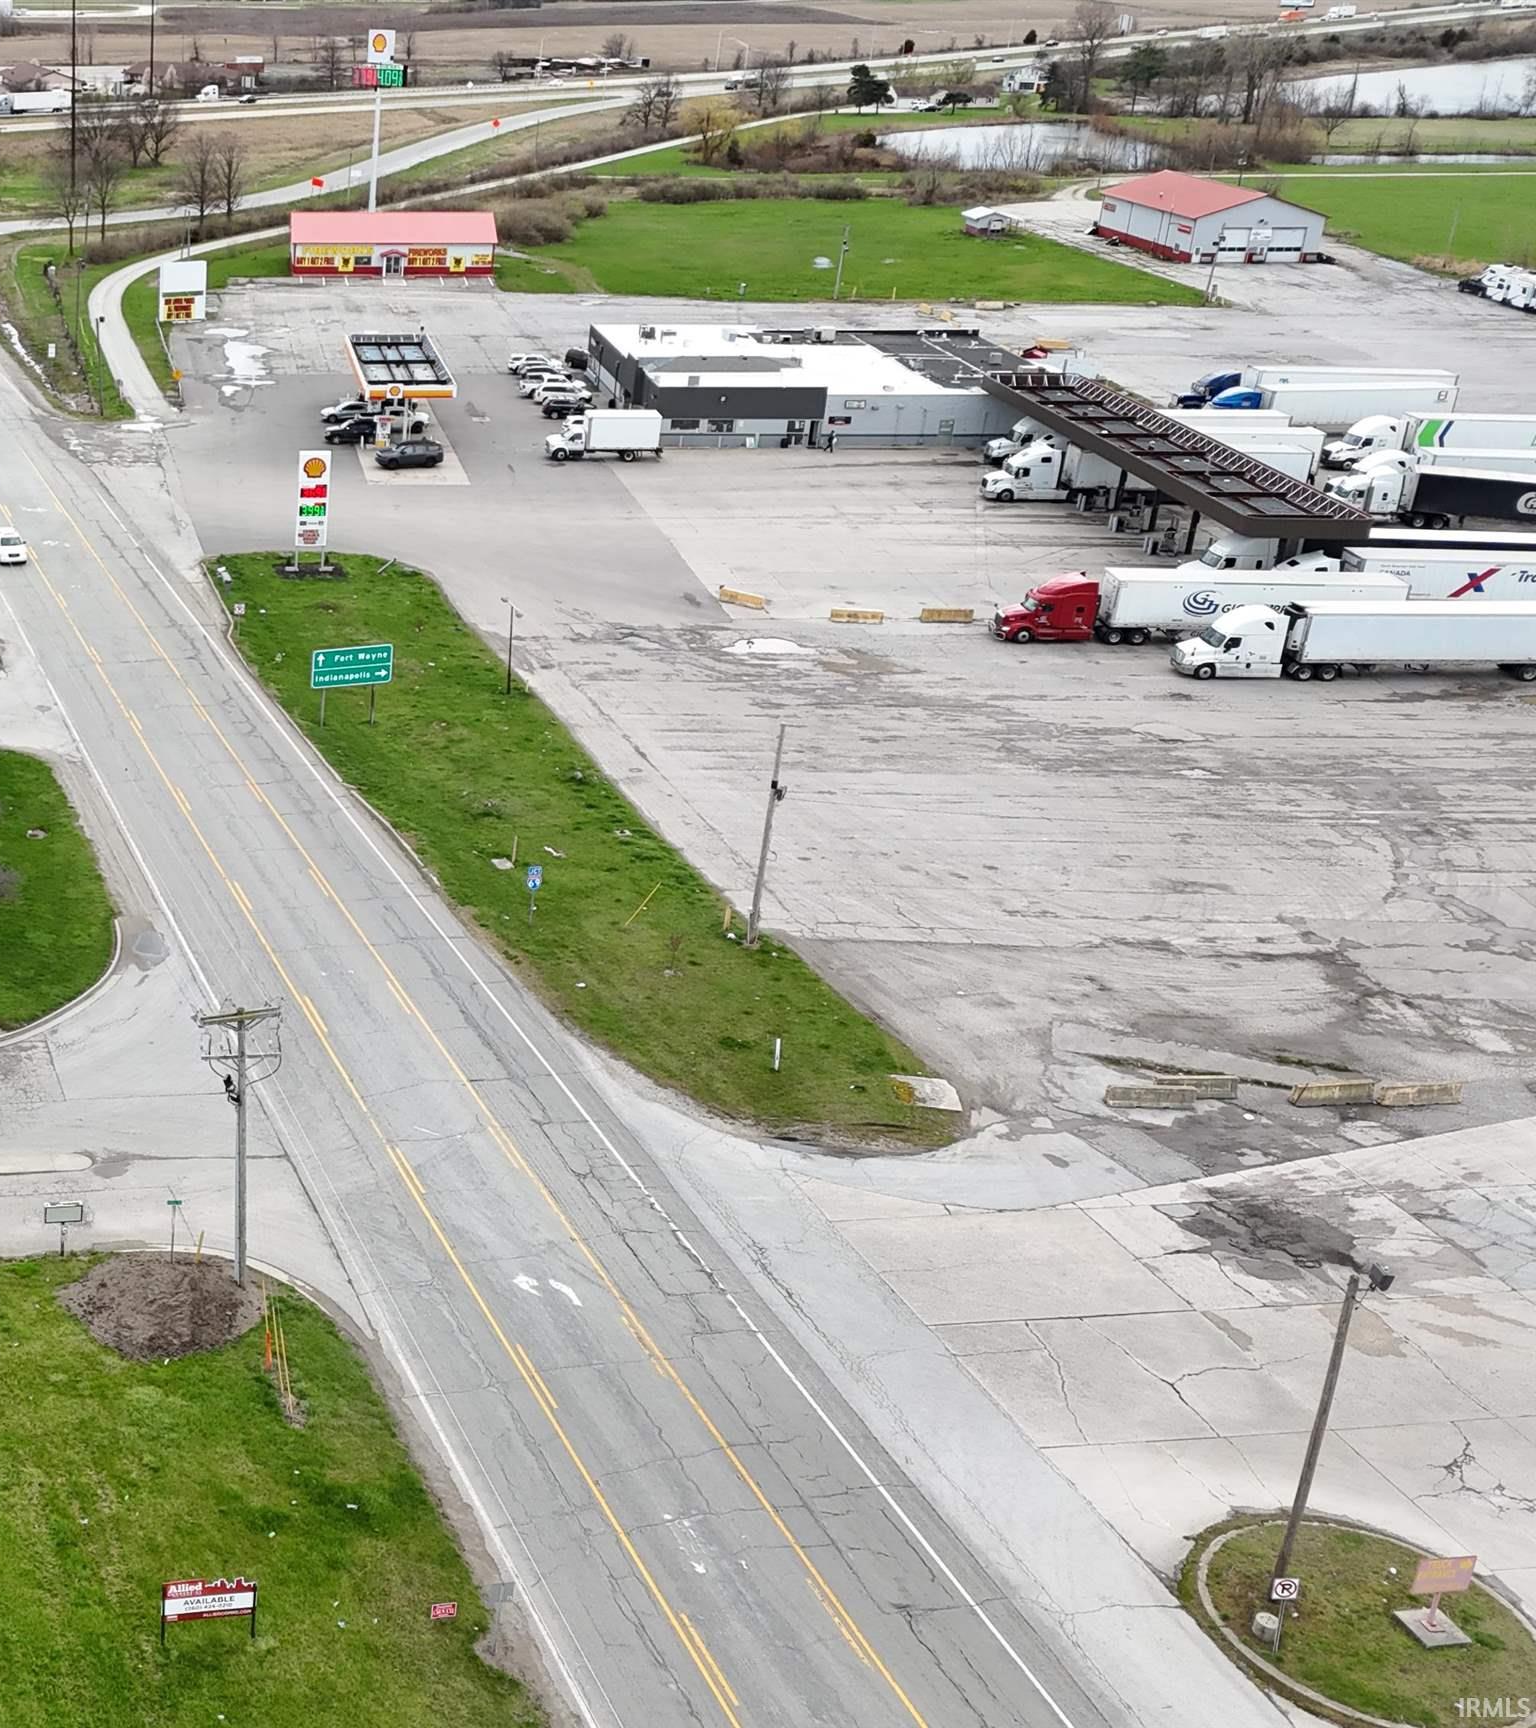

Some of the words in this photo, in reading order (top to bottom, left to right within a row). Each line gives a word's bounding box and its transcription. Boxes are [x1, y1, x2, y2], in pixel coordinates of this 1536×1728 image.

[334, 654, 353, 663] Fort
[358, 652, 388, 661] Wayne
[315, 671, 371, 683] Indianapolis
[168, 1582, 203, 1594] Allied
[183, 1595, 236, 1606] AVAILABLE
